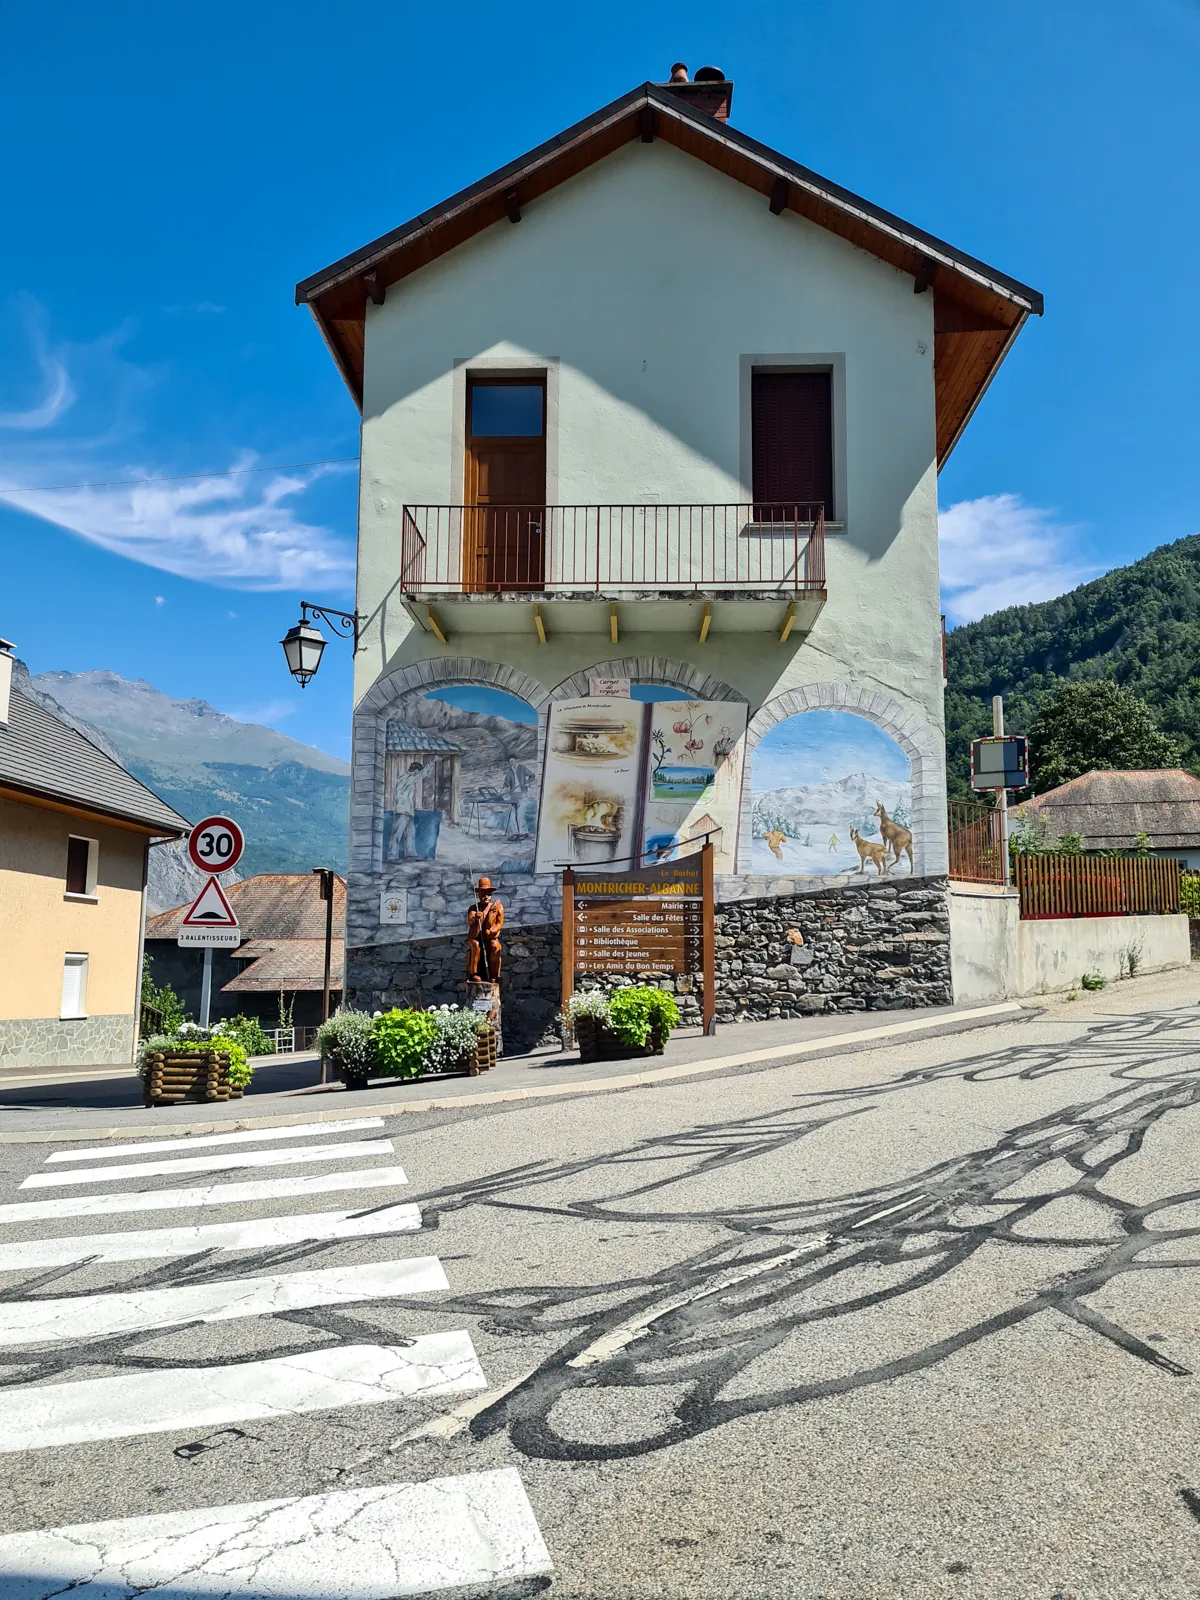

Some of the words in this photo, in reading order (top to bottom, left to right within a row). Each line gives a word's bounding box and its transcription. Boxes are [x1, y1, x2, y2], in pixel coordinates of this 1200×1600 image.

[199, 832, 233, 857] 30
[673, 869, 699, 877] Bochet
[577, 882, 699, 894] MONTRICHER-ALBANNE
[665, 913, 684, 921] Fêtes
[593, 937, 638, 946] Bibliothèque
[625, 950, 650, 959] Jeunes
[593, 962, 605, 970] Les
[606, 962, 624, 970] Amis
[636, 962, 650, 970] Bon
[651, 963, 675, 971] Temps
